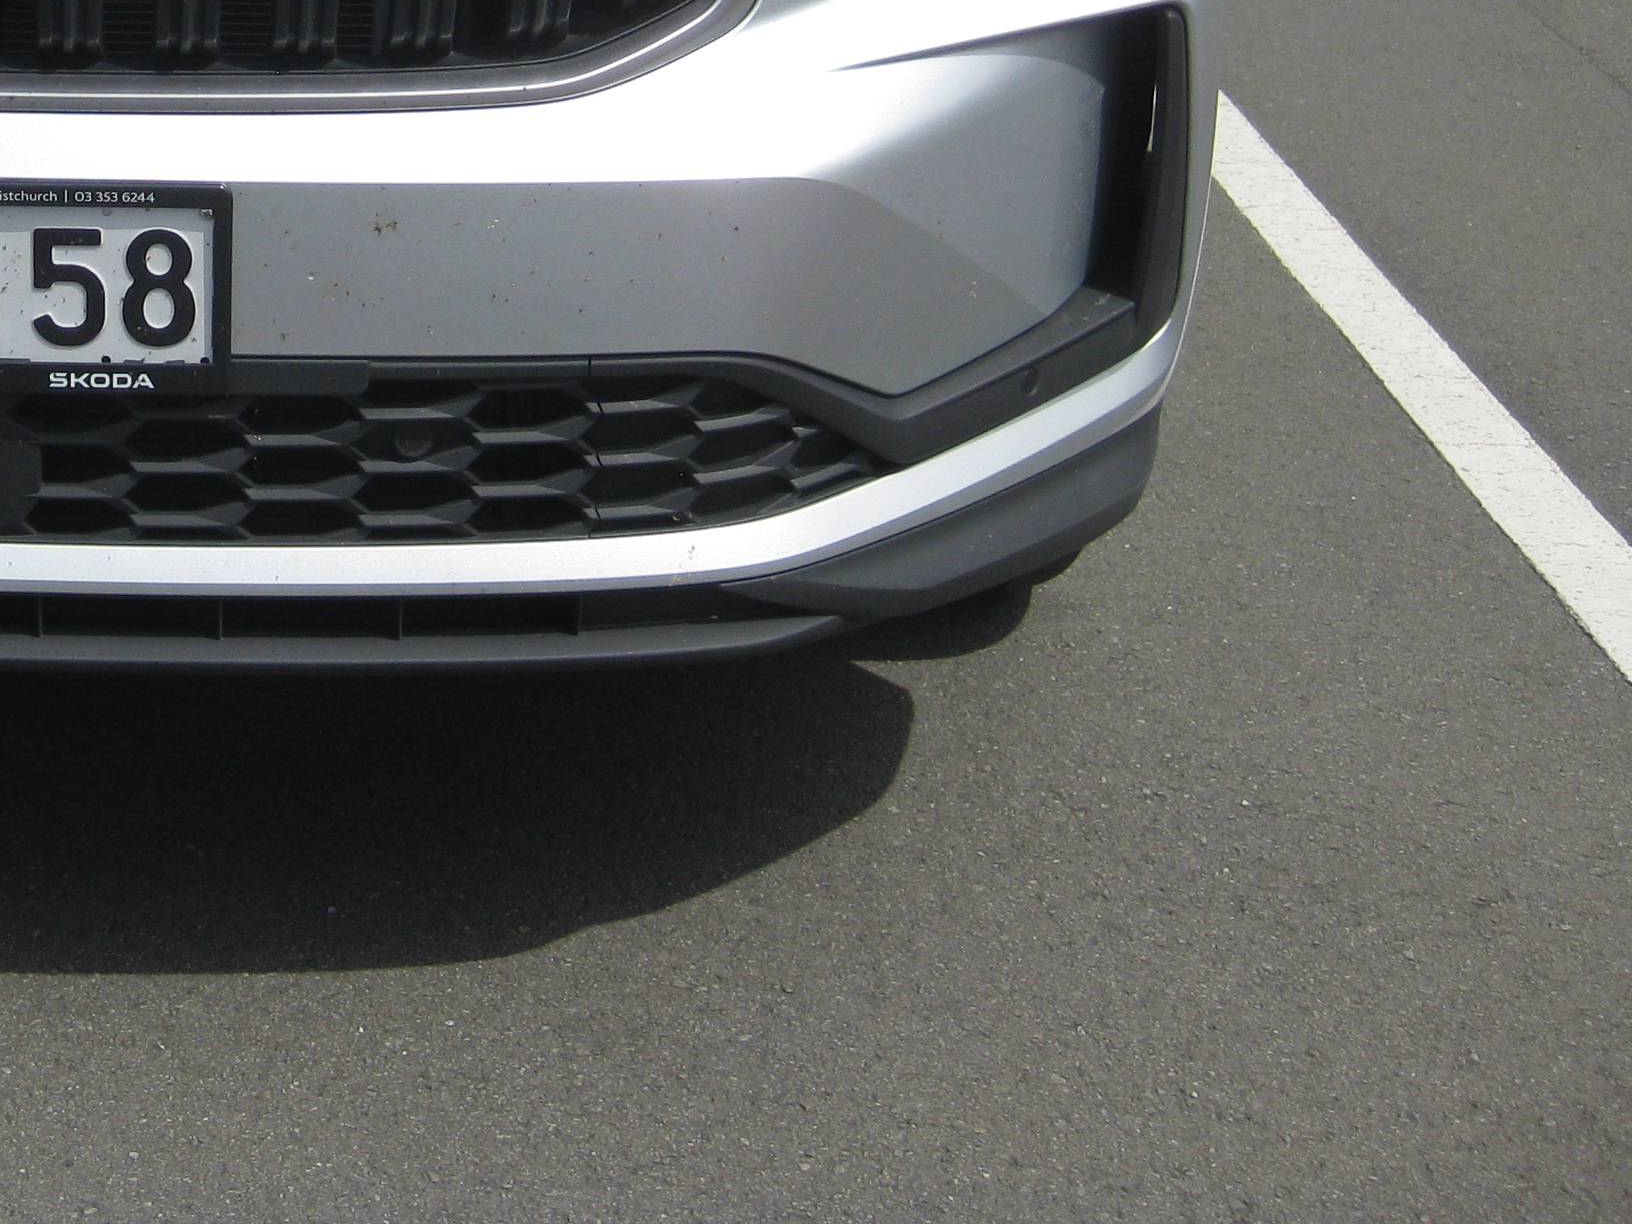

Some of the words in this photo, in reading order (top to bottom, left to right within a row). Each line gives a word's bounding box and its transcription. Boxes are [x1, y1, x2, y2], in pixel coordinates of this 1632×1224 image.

[74, 190, 92, 203] 03
[95, 191, 118, 203] 353
[121, 191, 156, 203] 6244
